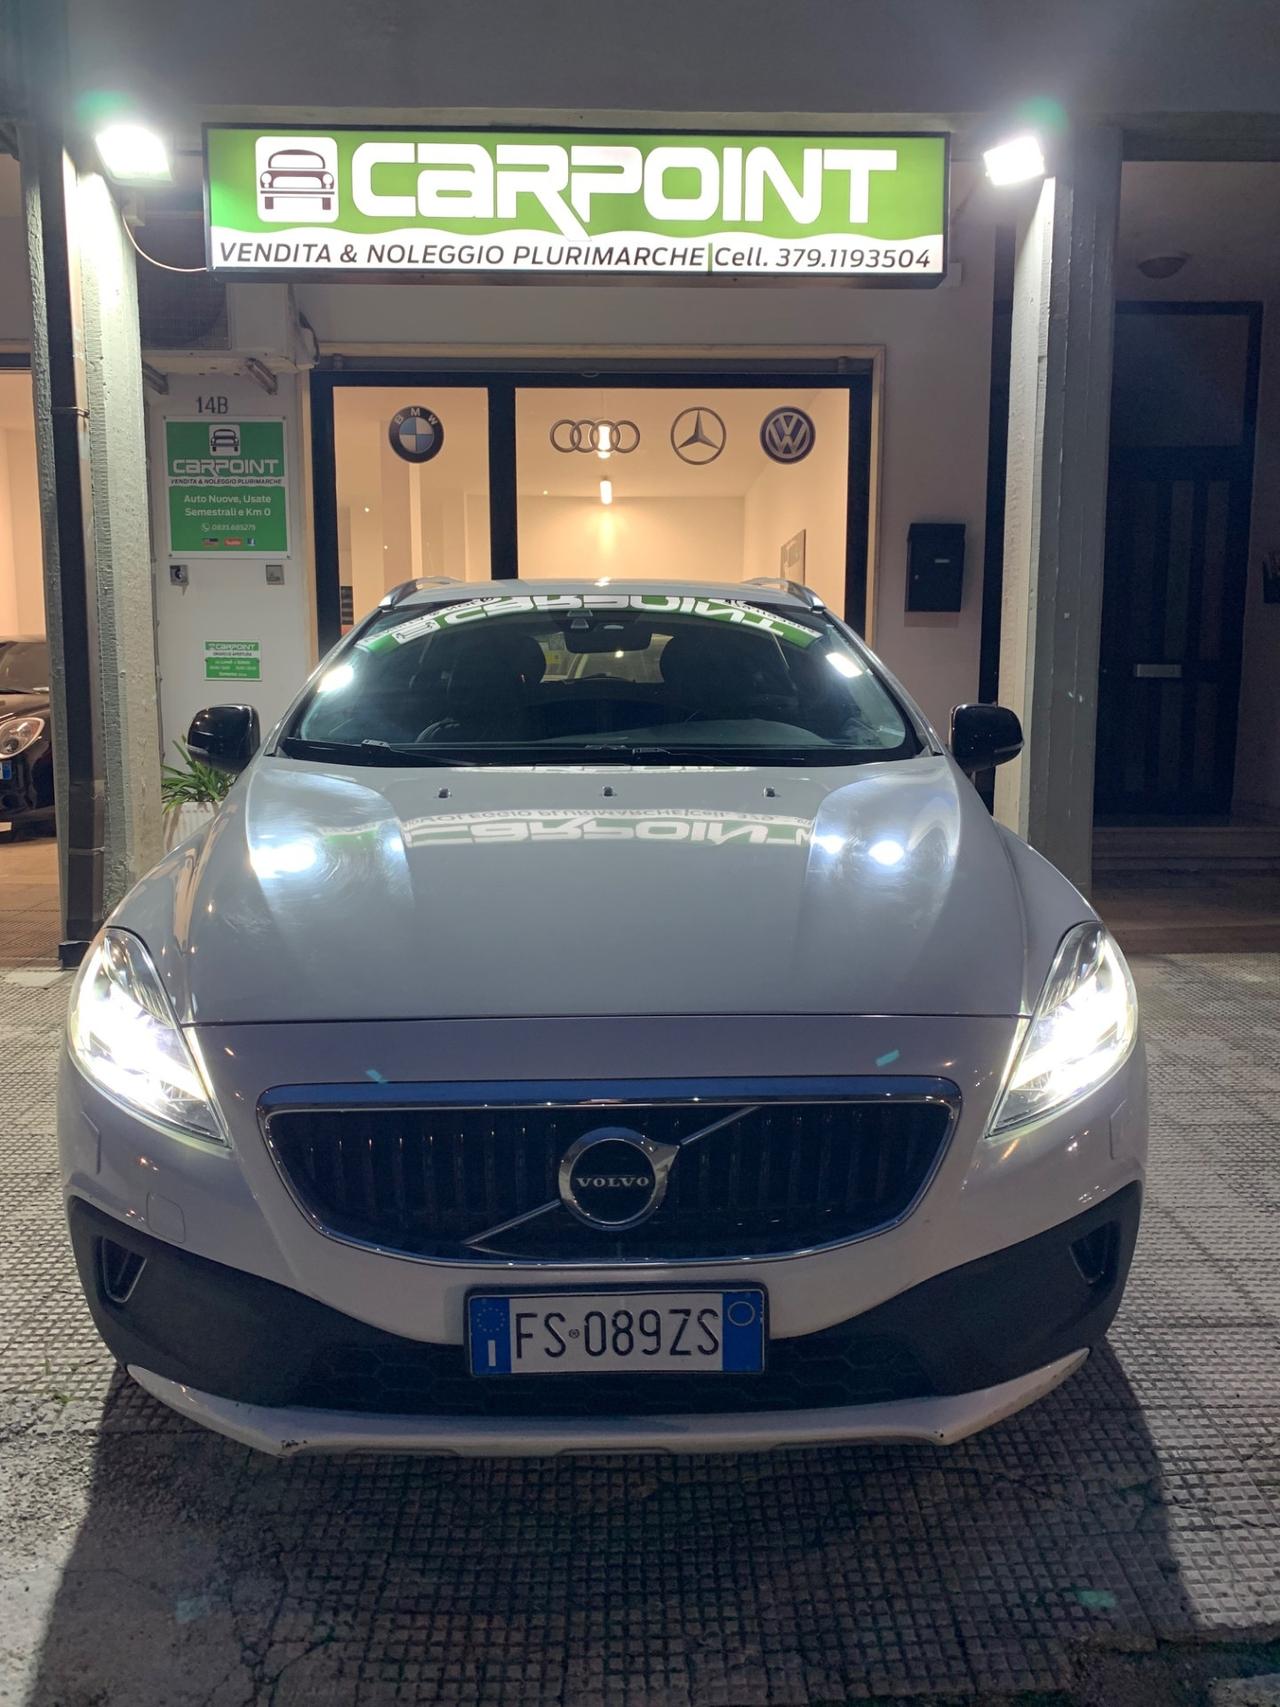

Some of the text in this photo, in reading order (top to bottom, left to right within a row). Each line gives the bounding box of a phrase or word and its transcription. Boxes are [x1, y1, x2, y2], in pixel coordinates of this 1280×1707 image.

[220, 242, 931, 268] VENDITA & NOLEGGIO PLURIMARCHE Cell. 379.1193504
[195, 396, 229, 414] 14B
[394, 407, 438, 425] BMW
[184, 495, 207, 503] Auto
[185, 508, 237, 517] Semestrali
[246, 508, 262, 516] Km
[576, 1176, 650, 1188] VOLVO
